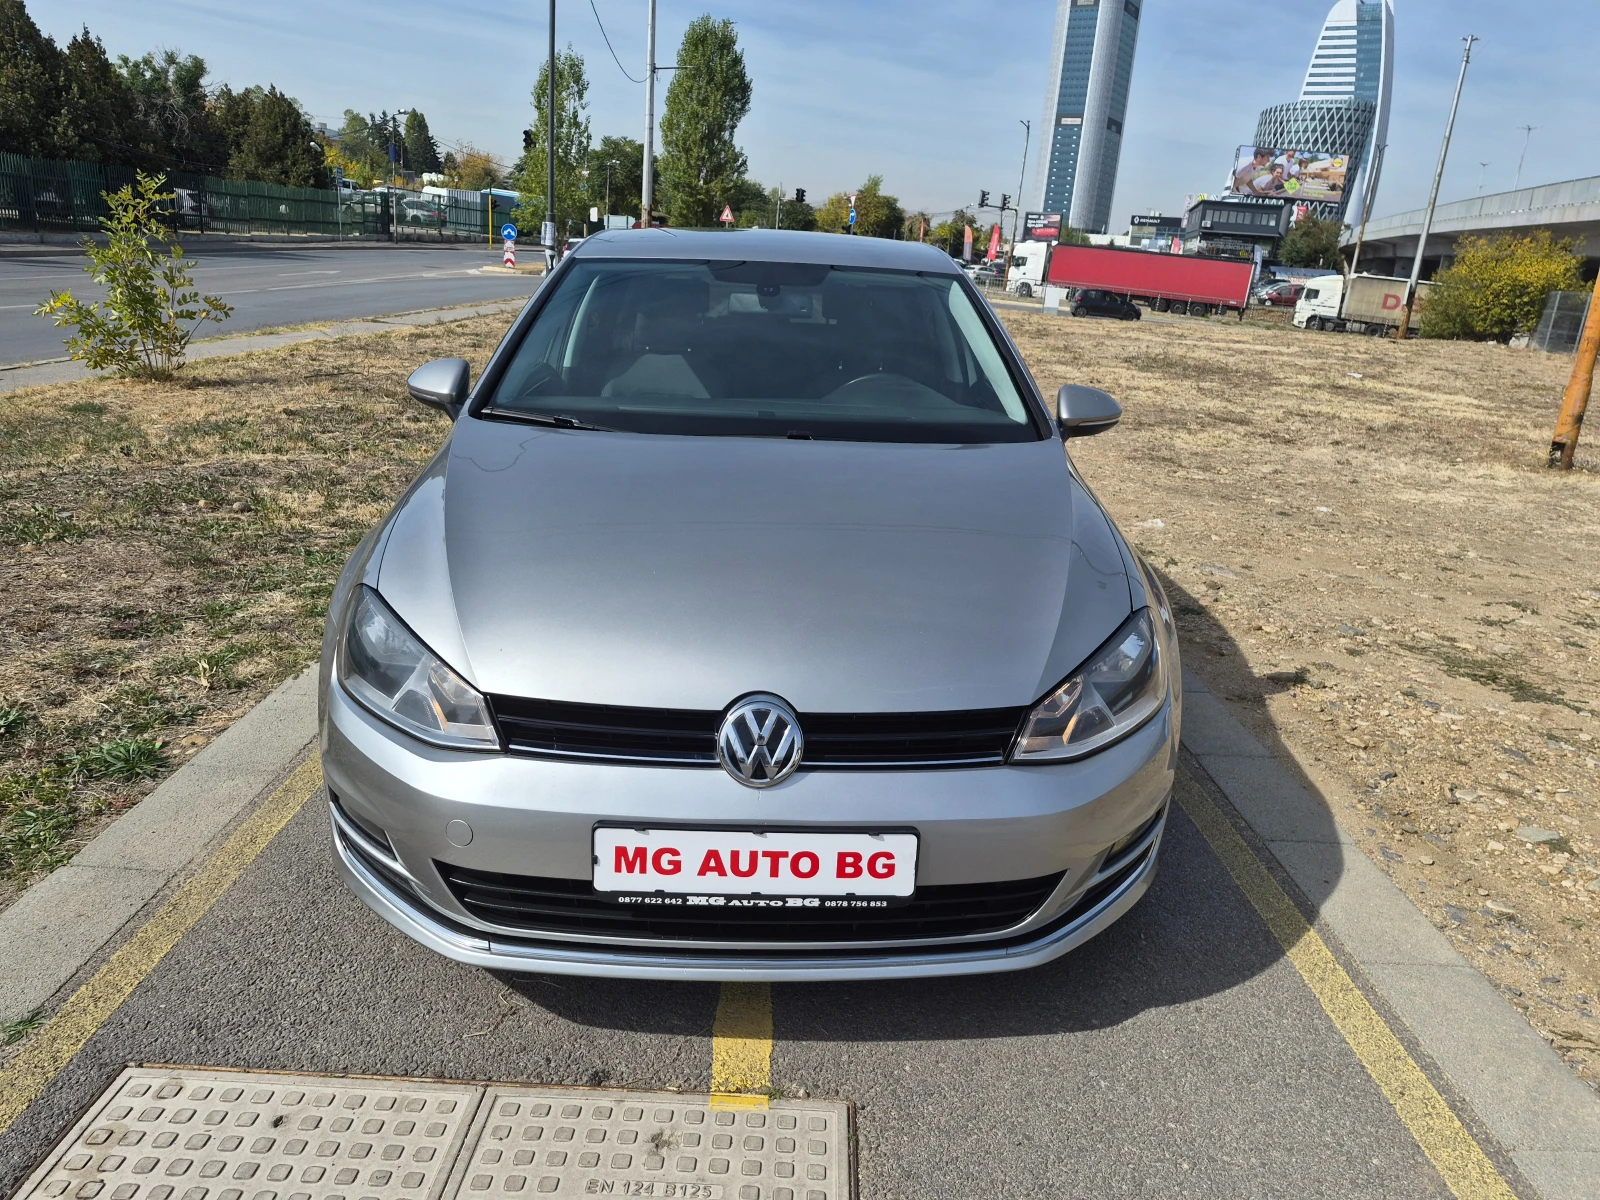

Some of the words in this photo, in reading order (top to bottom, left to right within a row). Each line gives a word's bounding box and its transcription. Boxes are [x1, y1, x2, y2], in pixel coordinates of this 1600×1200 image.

[613, 845, 682, 876] MG
[697, 849, 820, 879] AUTO
[835, 850, 896, 880] BG
[618, 896, 642, 904] 0877
[686, 895, 727, 906] MG
[727, 899, 783, 907] AUTO
[785, 897, 821, 907] BG
[585, 1178, 615, 1194] EN
[622, 1180, 655, 1197] 124
[663, 1183, 713, 1199] B125
